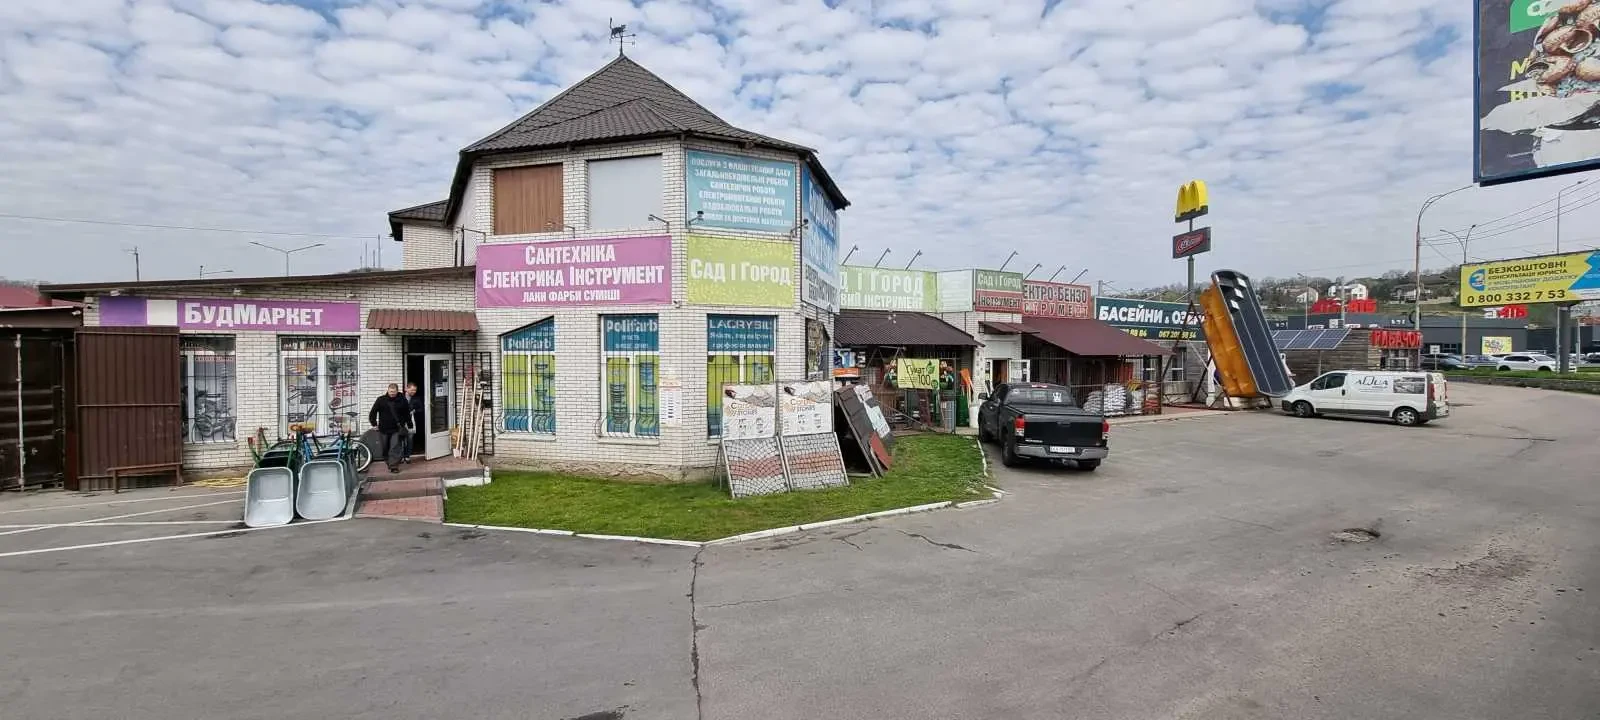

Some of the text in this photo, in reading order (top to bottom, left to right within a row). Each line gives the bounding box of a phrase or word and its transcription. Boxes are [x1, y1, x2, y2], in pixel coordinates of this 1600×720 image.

[525, 244, 616, 265] САНТЕХНІКА
[690, 258, 726, 283] САД
[740, 261, 792, 286] ГОРОД
[1488, 260, 1566, 275] БЕЗКОШТОВНІ
[1537, 269, 1567, 277] ЮРИСТА
[482, 265, 665, 289] ЕЛЕКТРИКА ІНСТРУМЕНТ
[870, 270, 924, 296] ГОРОД
[522, 289, 620, 303] ЛАКИ ФАРБИ СУМІШІ
[1467, 289, 1565, 304] 0 800 332 7 53
[1099, 304, 1163, 324] БАСЕЙНИ
[606, 319, 657, 333] Polifarb
[709, 319, 771, 330] LACRYSIL
[918, 374, 931, 386] 100
